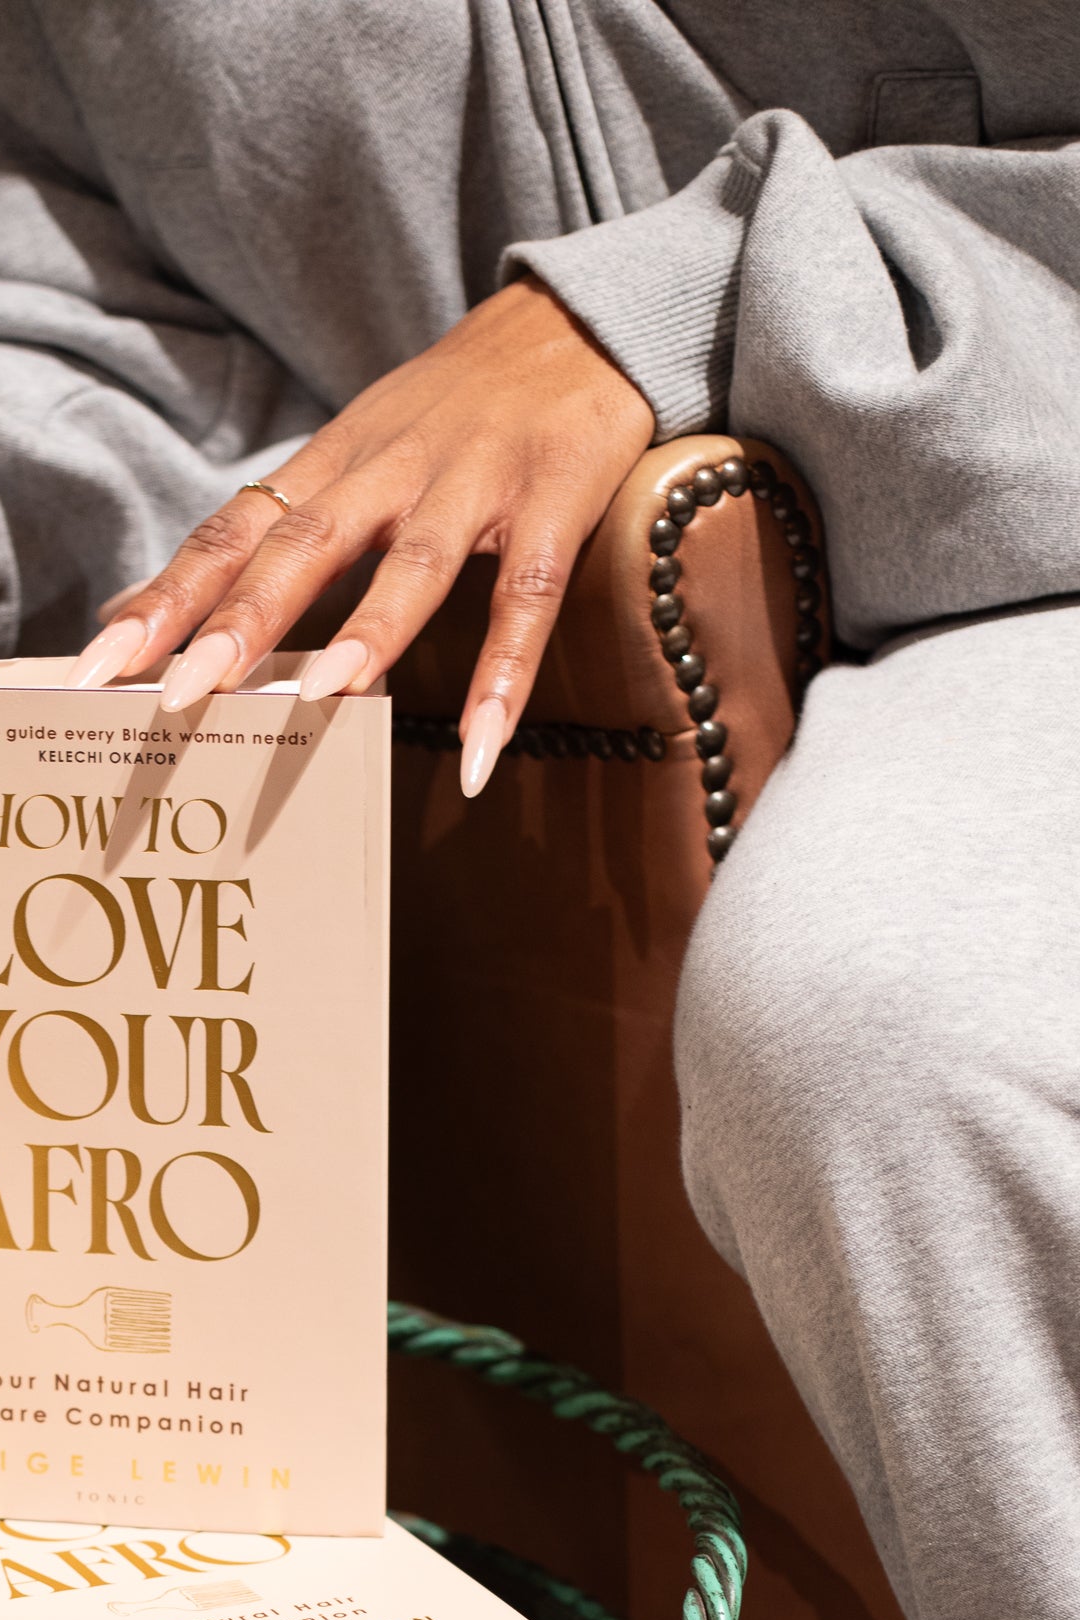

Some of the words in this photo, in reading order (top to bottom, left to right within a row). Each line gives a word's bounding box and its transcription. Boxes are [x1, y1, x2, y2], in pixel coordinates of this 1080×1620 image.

[6, 726, 57, 743] guide
[65, 730, 115, 745] every
[122, 728, 171, 743] Black
[179, 732, 245, 745] woman
[38, 750, 103, 763] KELECHI
[109, 751, 177, 766] OKAFOR
[139, 796, 228, 855] TO
[54, 1374, 169, 1398] Natural
[187, 1381, 249, 1402] Hair
[66, 1407, 244, 1435] Companion
[131, 1458, 292, 1490] LEWIN
[76, 1490, 146, 1506] TONIC
[0, 1534, 292, 1599] AFRO
[293, 1595, 357, 1613] Hair
